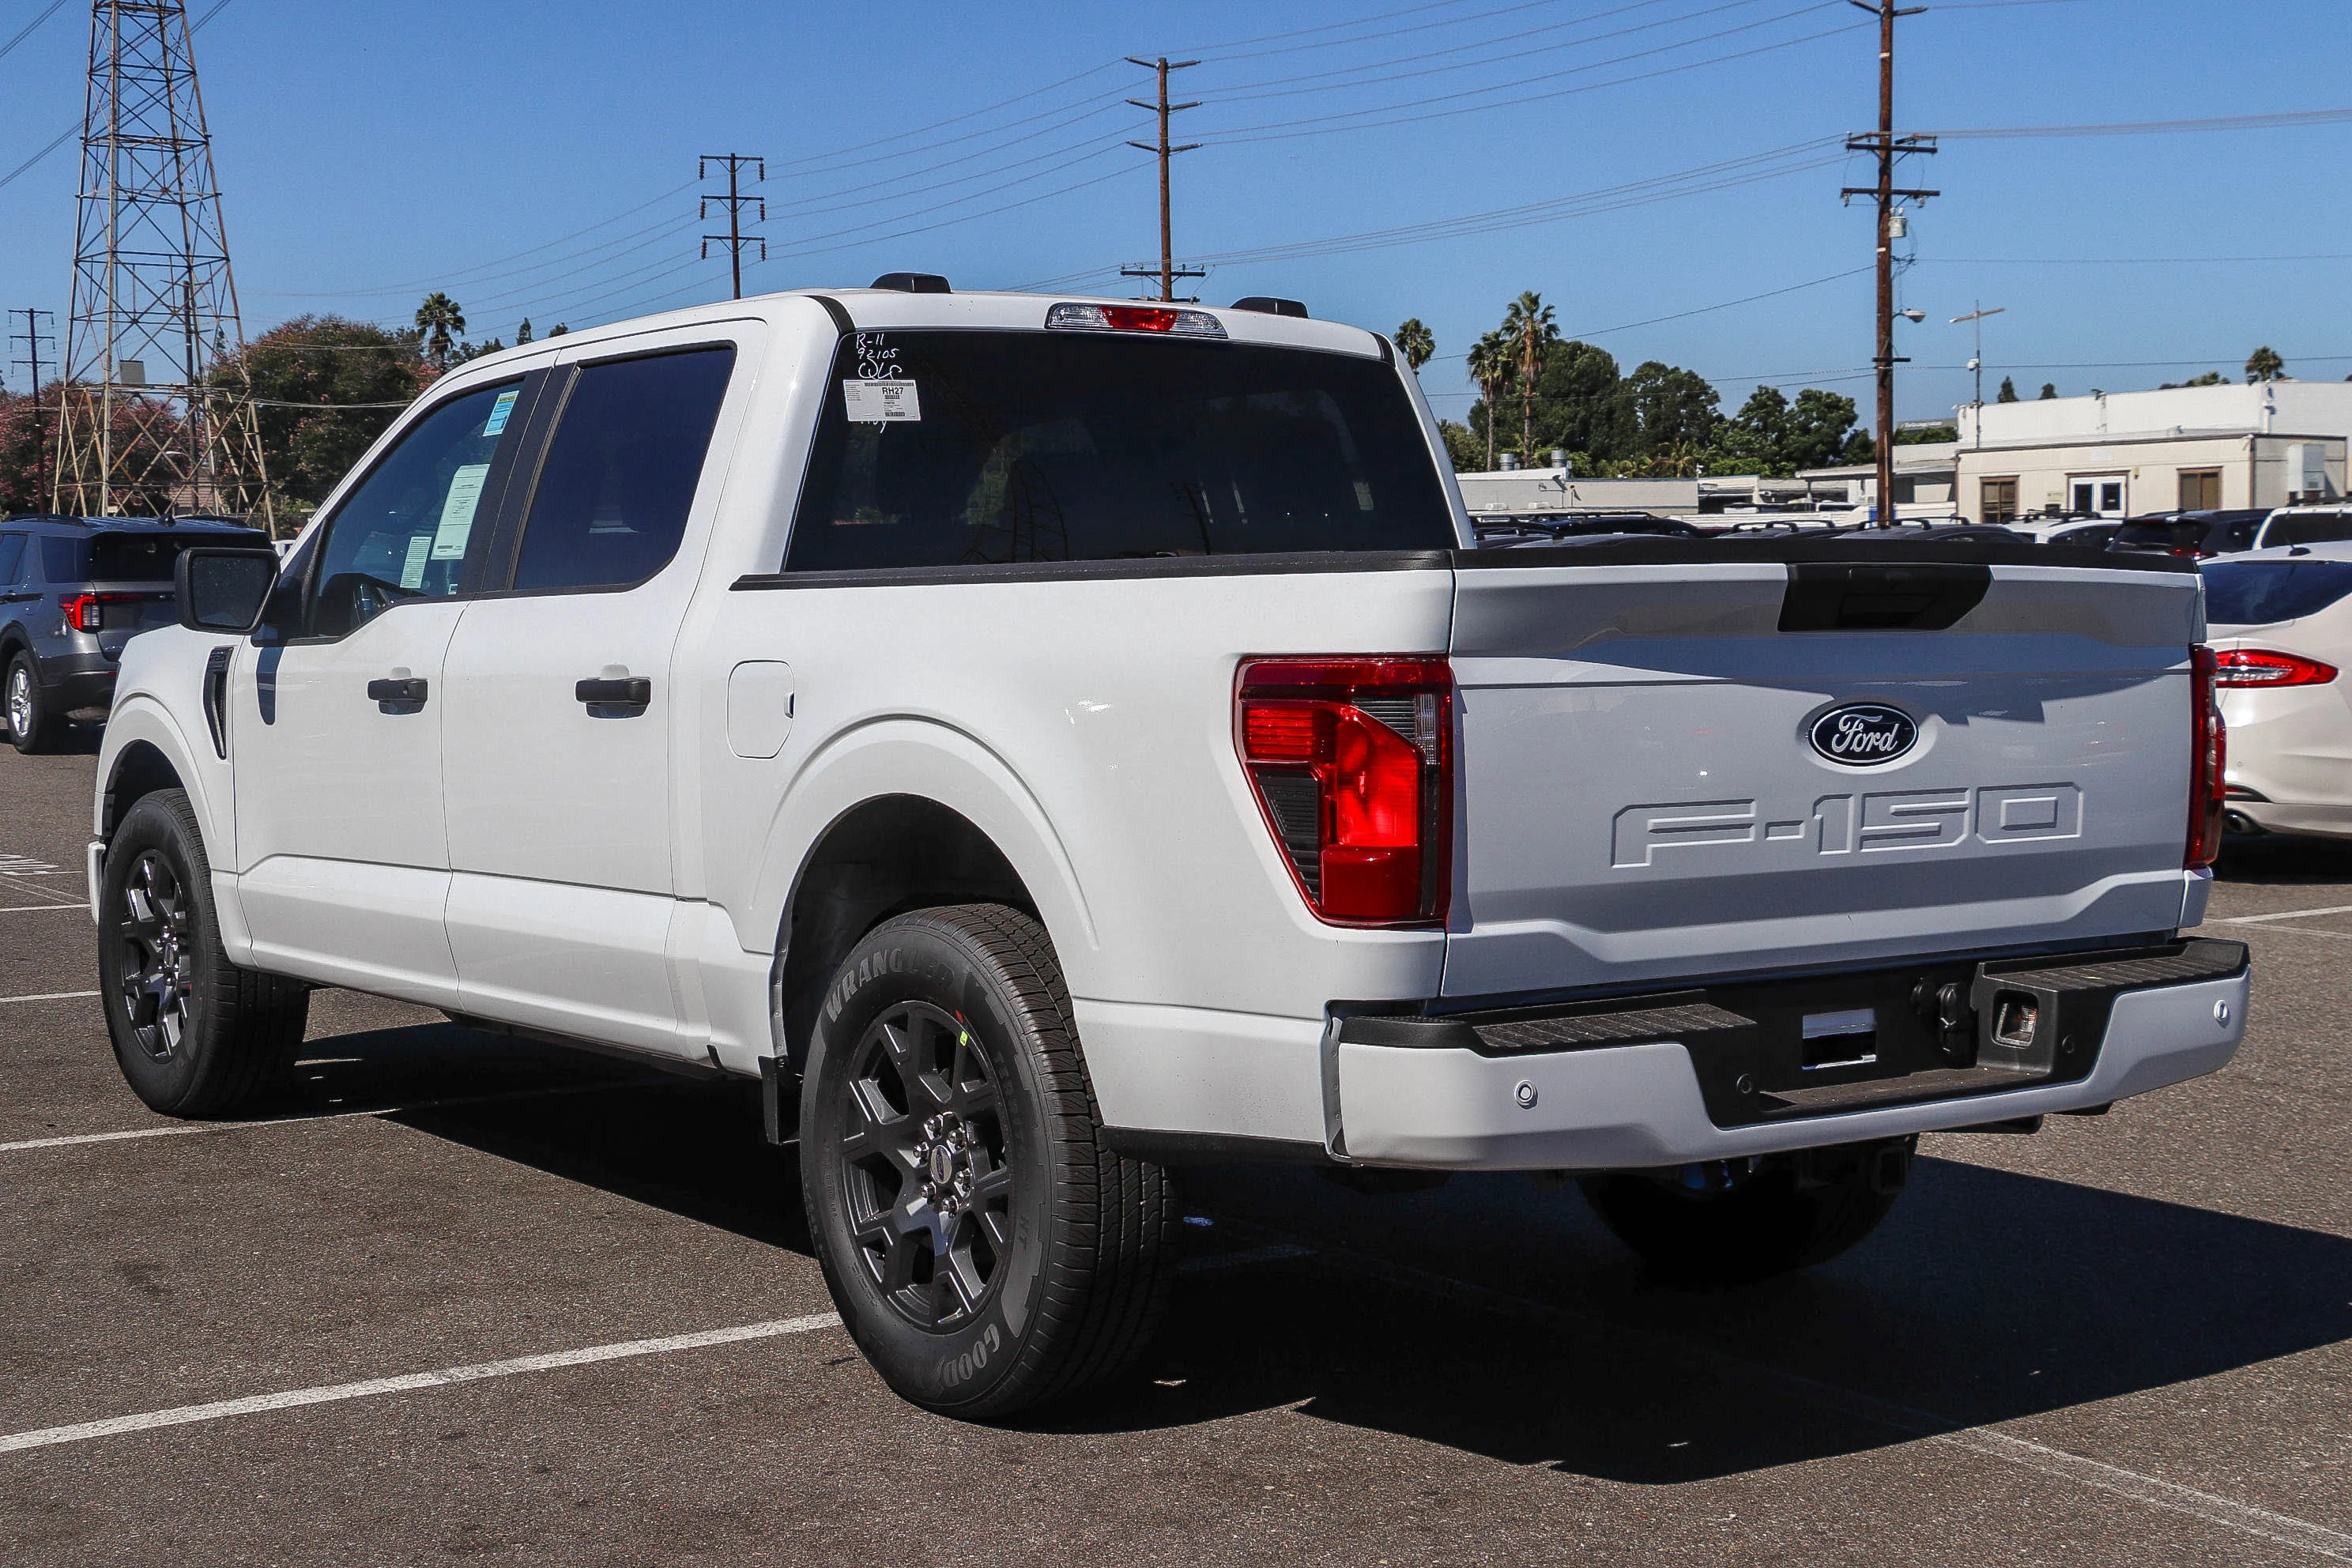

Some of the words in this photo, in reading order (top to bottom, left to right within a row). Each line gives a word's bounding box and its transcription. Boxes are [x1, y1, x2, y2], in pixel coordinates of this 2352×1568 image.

[858, 348, 899, 360] 92105
[881, 386, 904, 395] RH27
[1831, 713, 1899, 753] Ford
[1611, 782, 2085, 869] F-150
